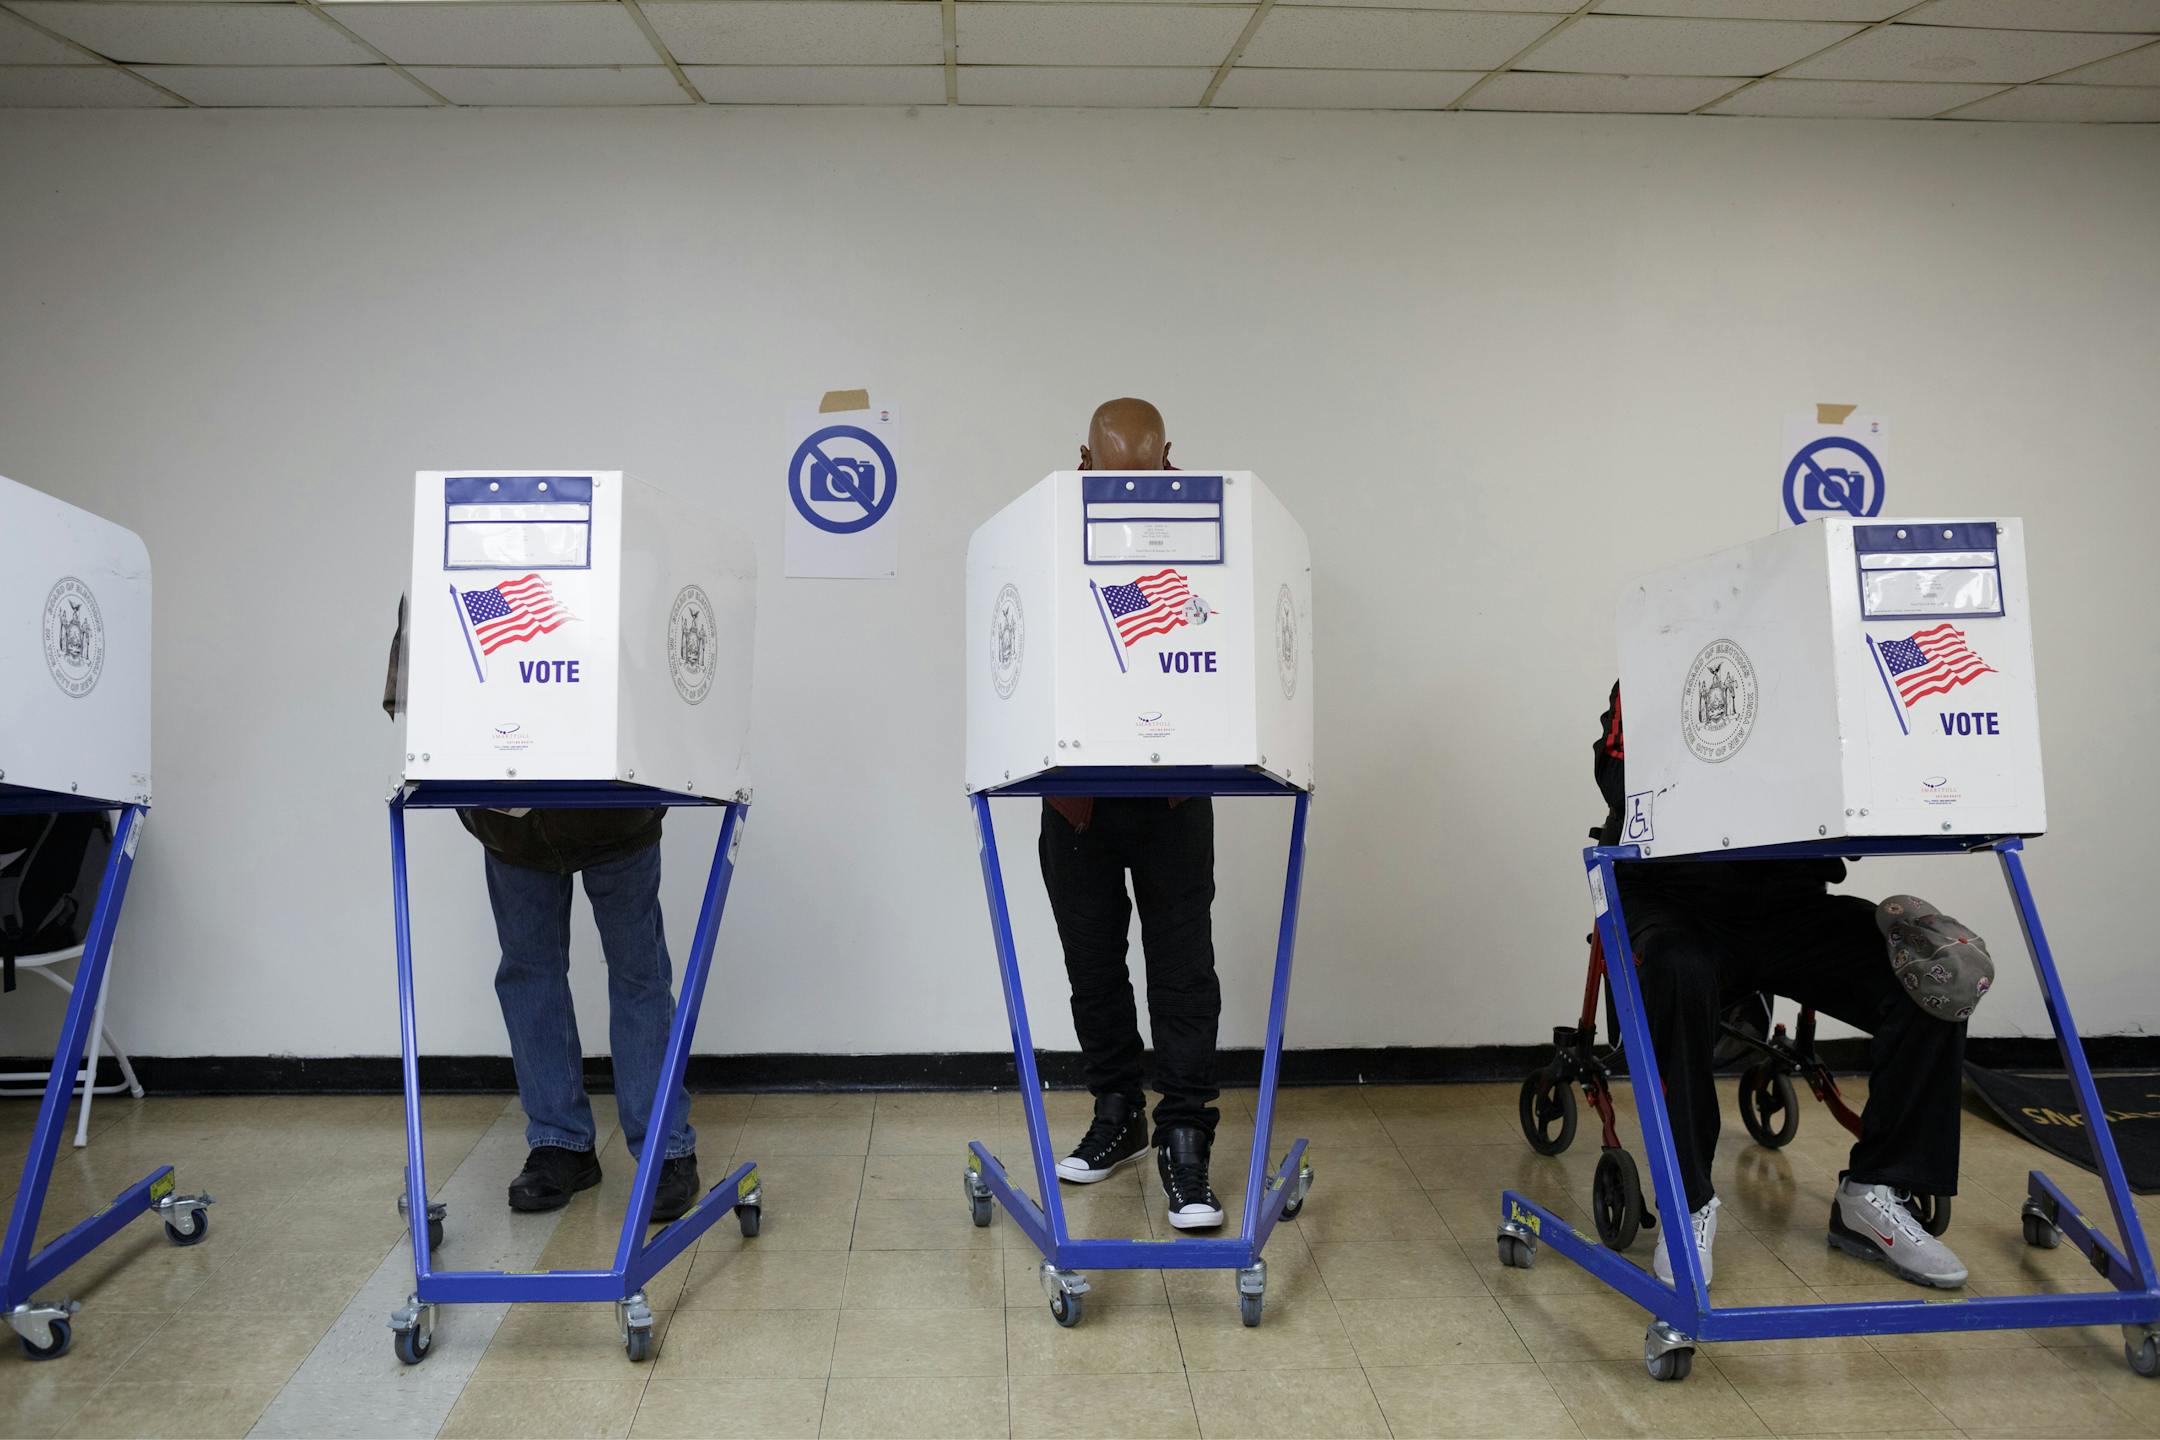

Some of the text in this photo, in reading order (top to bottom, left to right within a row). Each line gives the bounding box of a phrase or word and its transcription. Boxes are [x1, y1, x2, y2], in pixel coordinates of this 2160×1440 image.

[519, 660, 580, 684] VOTE
[1158, 651, 1217, 674] VOTE
[1939, 712, 2000, 736] VOTE
